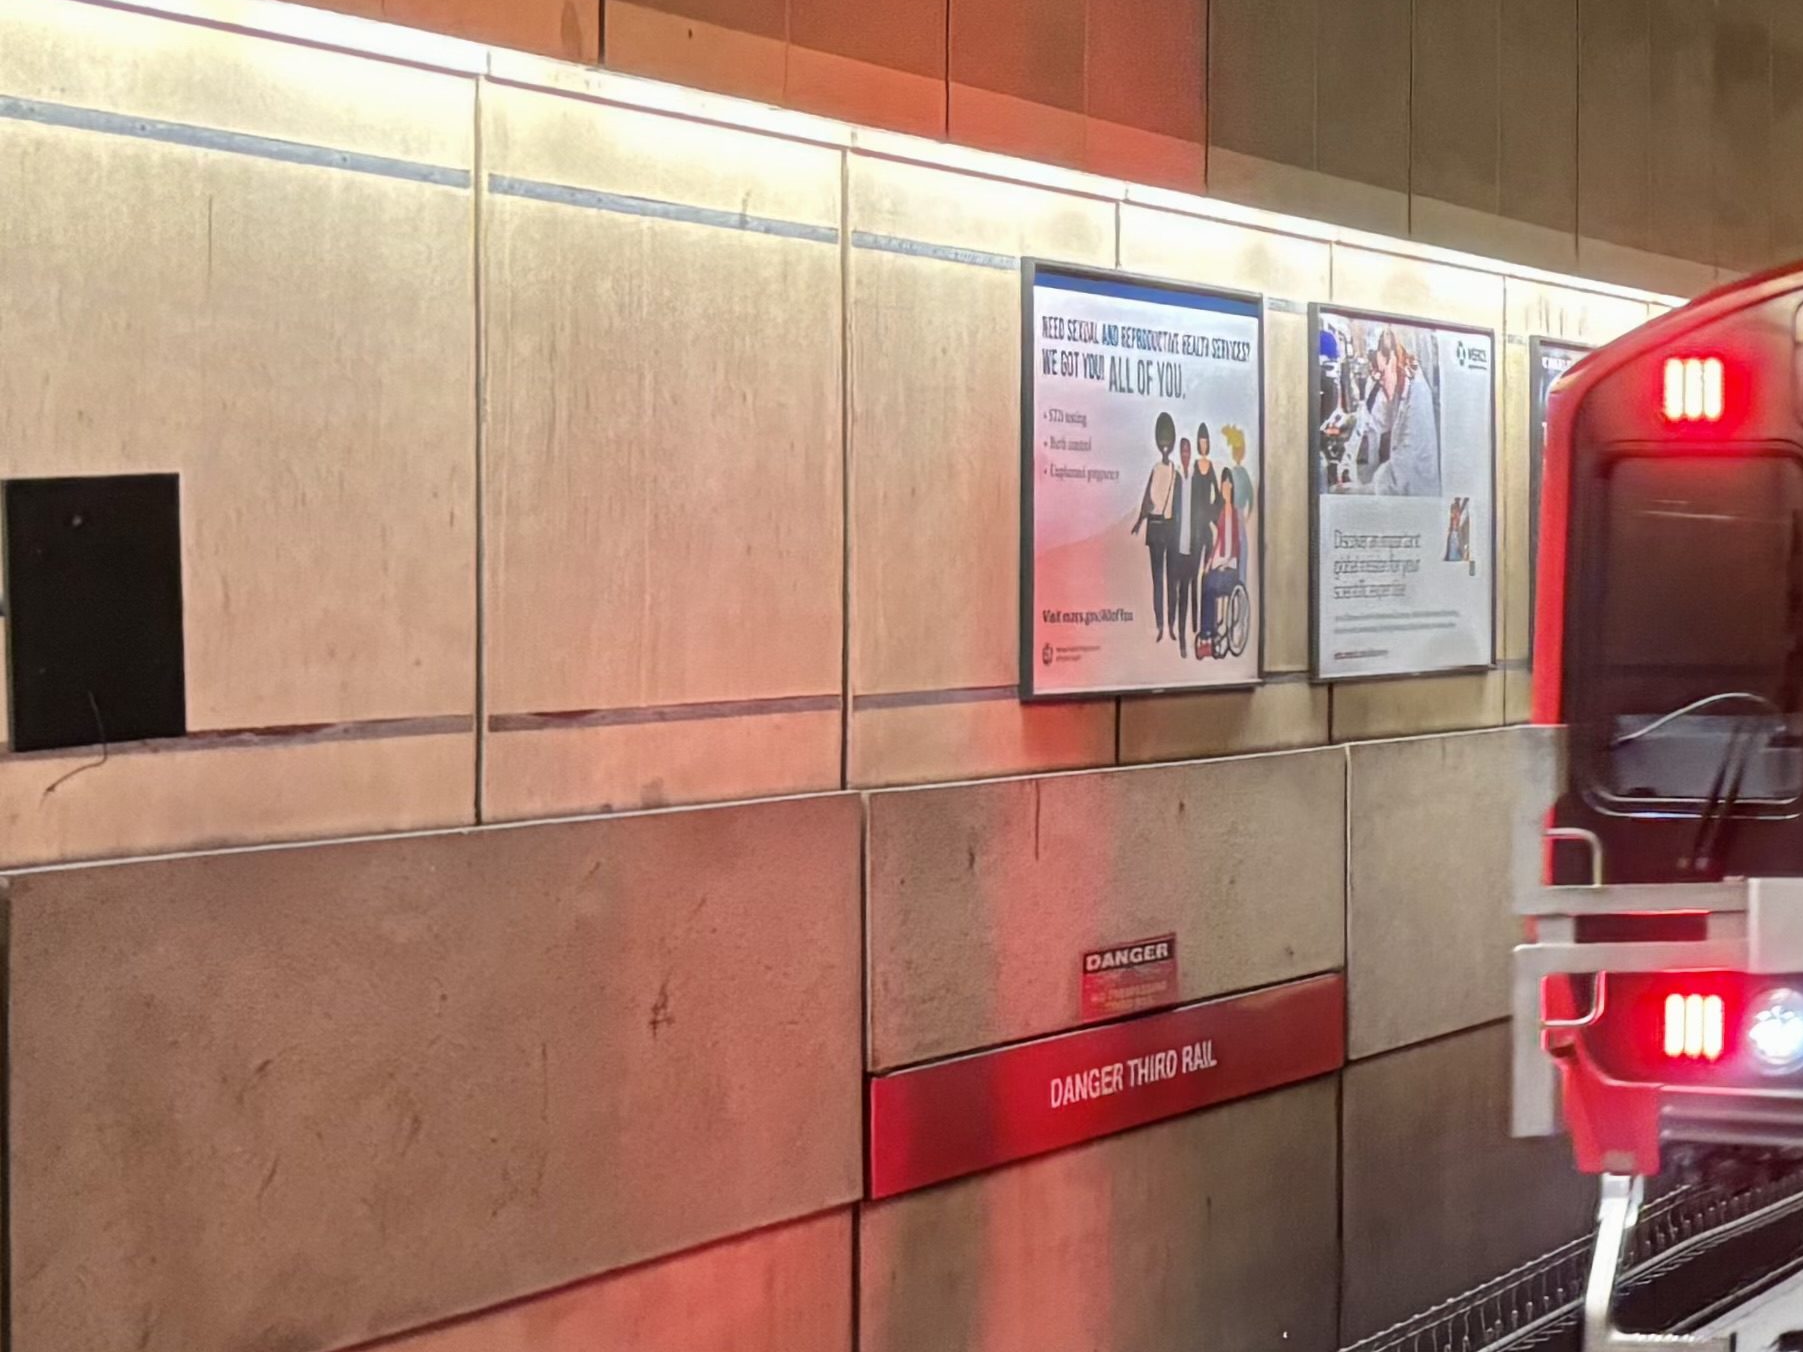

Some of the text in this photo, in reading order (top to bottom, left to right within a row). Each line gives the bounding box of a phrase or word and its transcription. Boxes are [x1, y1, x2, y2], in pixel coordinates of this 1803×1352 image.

[1042, 316, 1065, 340] NEED
[1101, 323, 1118, 347] AND
[1042, 348, 1057, 376] WE
[1060, 352, 1079, 377] GOT
[1109, 356, 1134, 394] ALL
[1137, 359, 1153, 397] OF
[1158, 363, 1186, 400] YOU.
[1086, 942, 1169, 972] DANGER
[1050, 1039, 1217, 1109] DANGER THIRD RAIL
